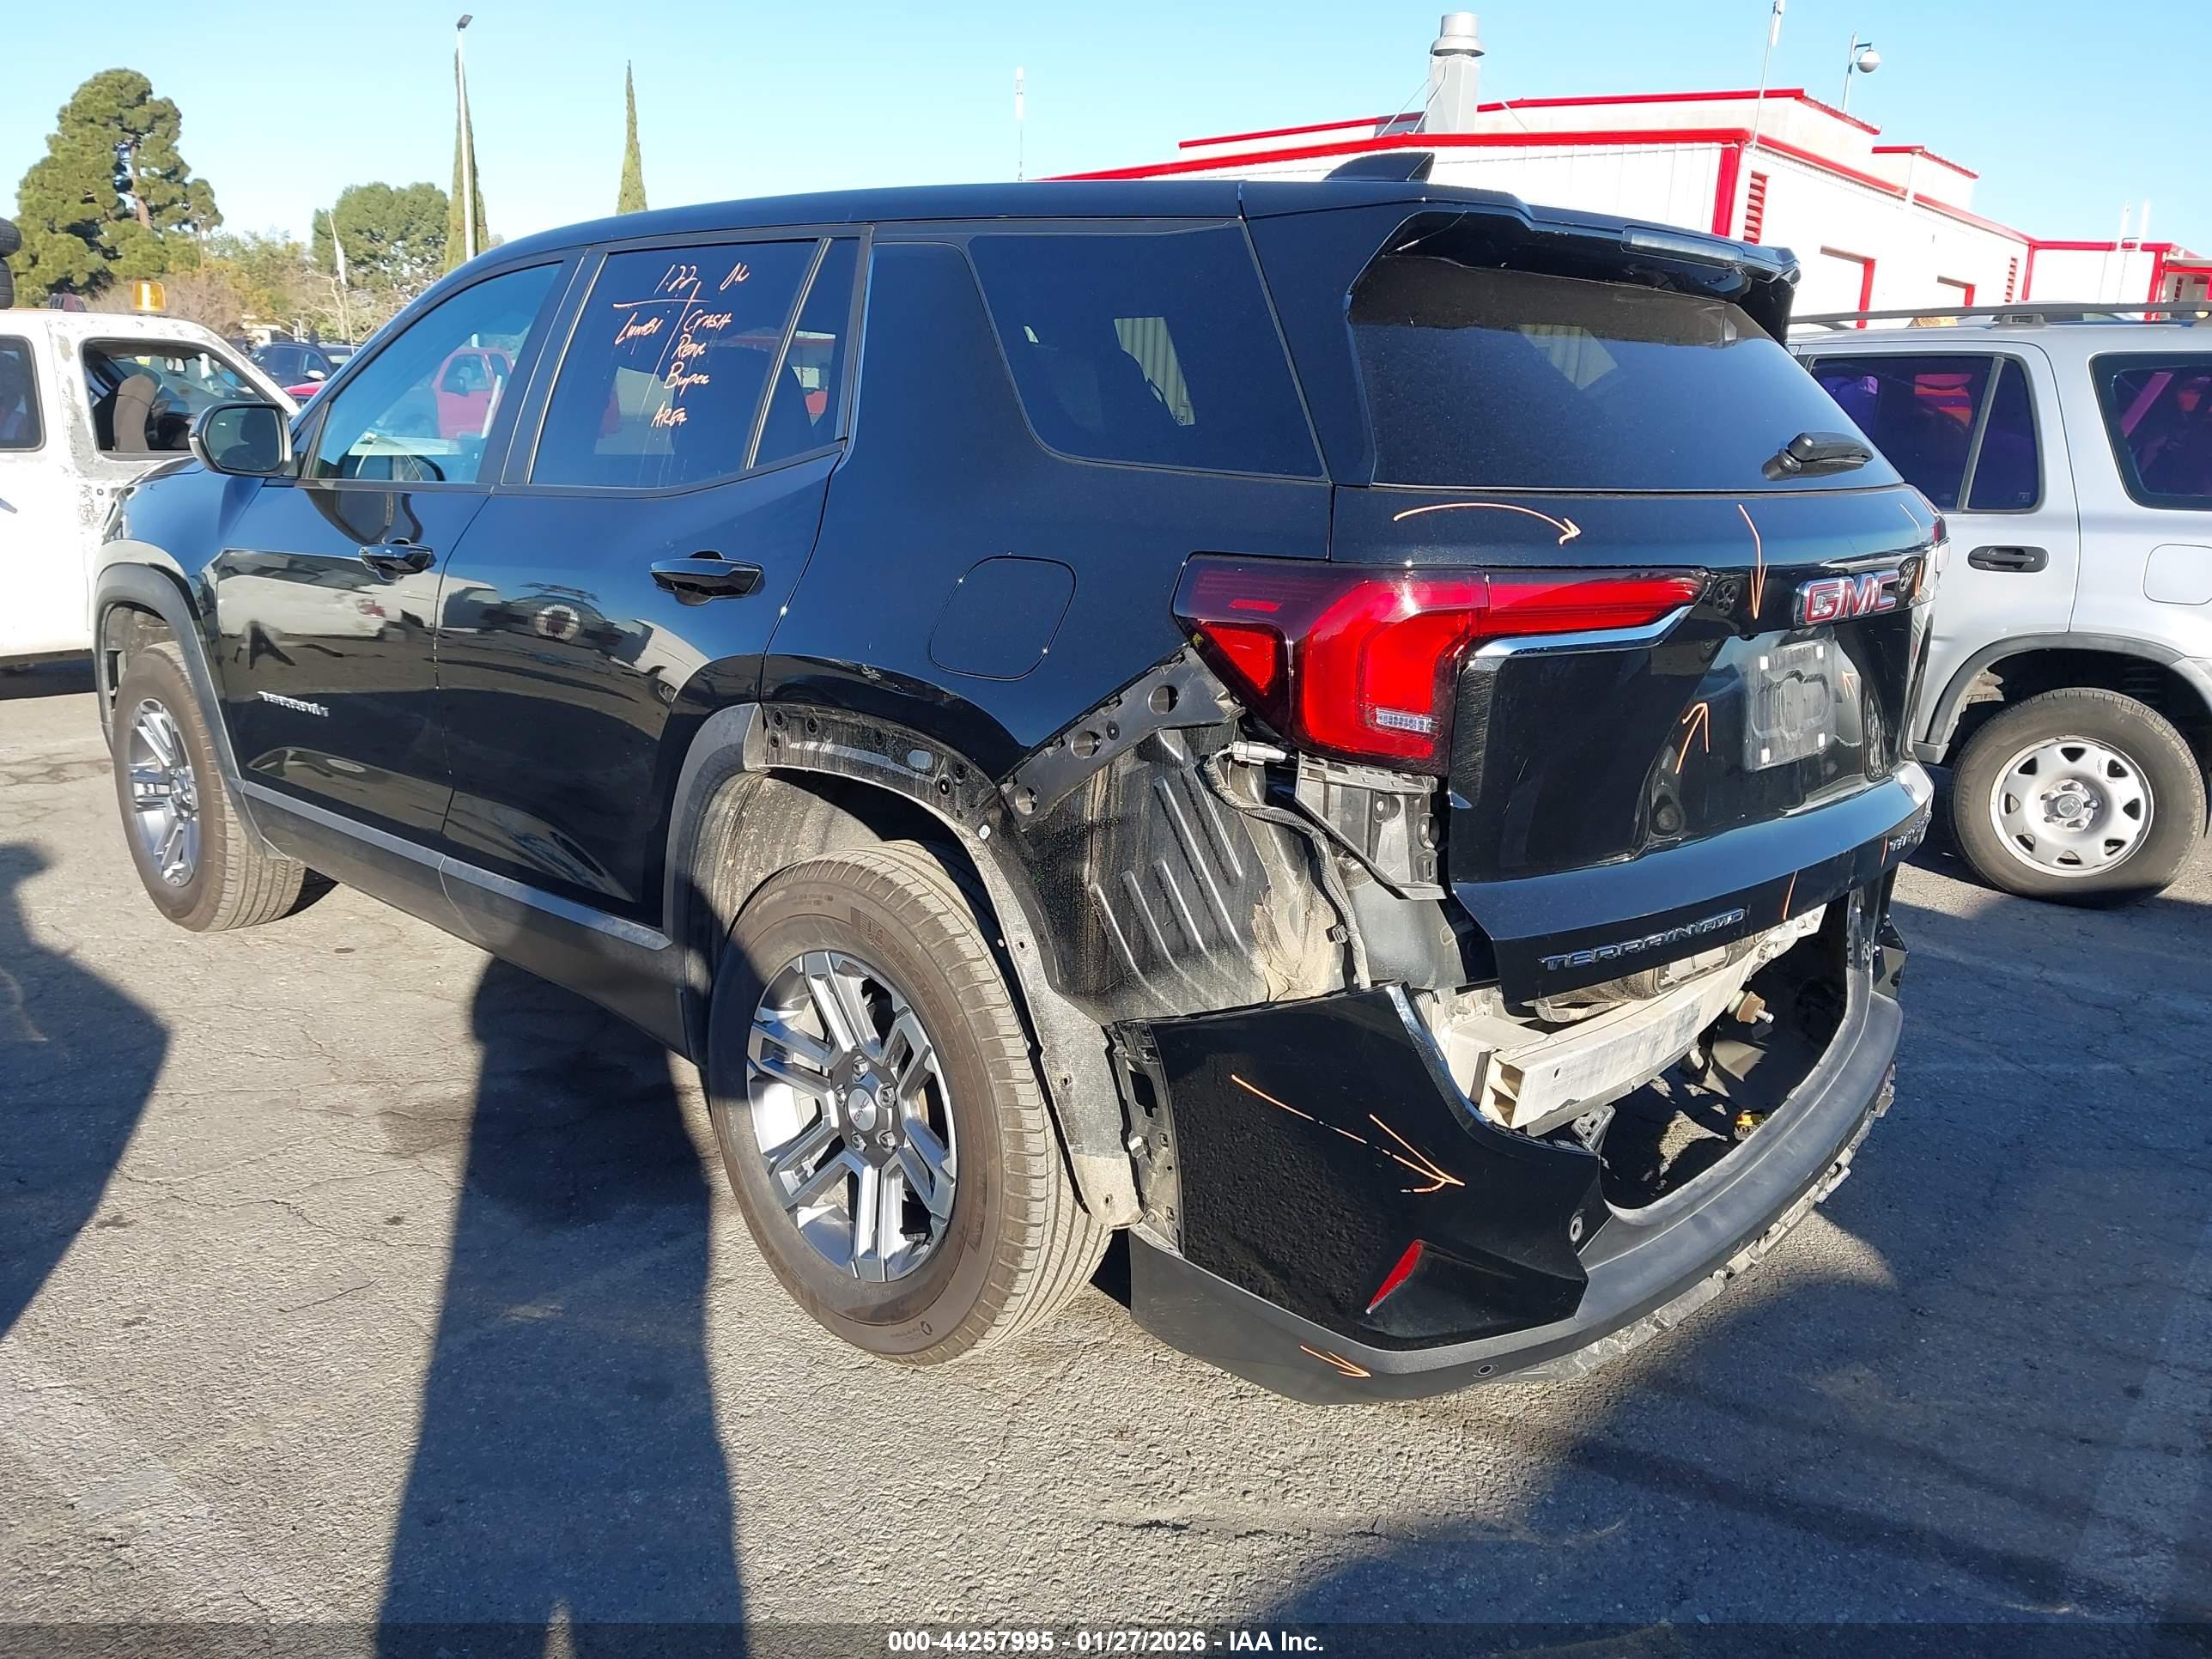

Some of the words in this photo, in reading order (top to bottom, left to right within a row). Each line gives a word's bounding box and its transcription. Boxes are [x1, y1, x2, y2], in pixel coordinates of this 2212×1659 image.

[1800, 569, 1900, 624] GMC
[257, 690, 330, 718] TERRAIN
[1537, 922, 1695, 971] TERRAIN
[1698, 907, 1746, 934] AWD
